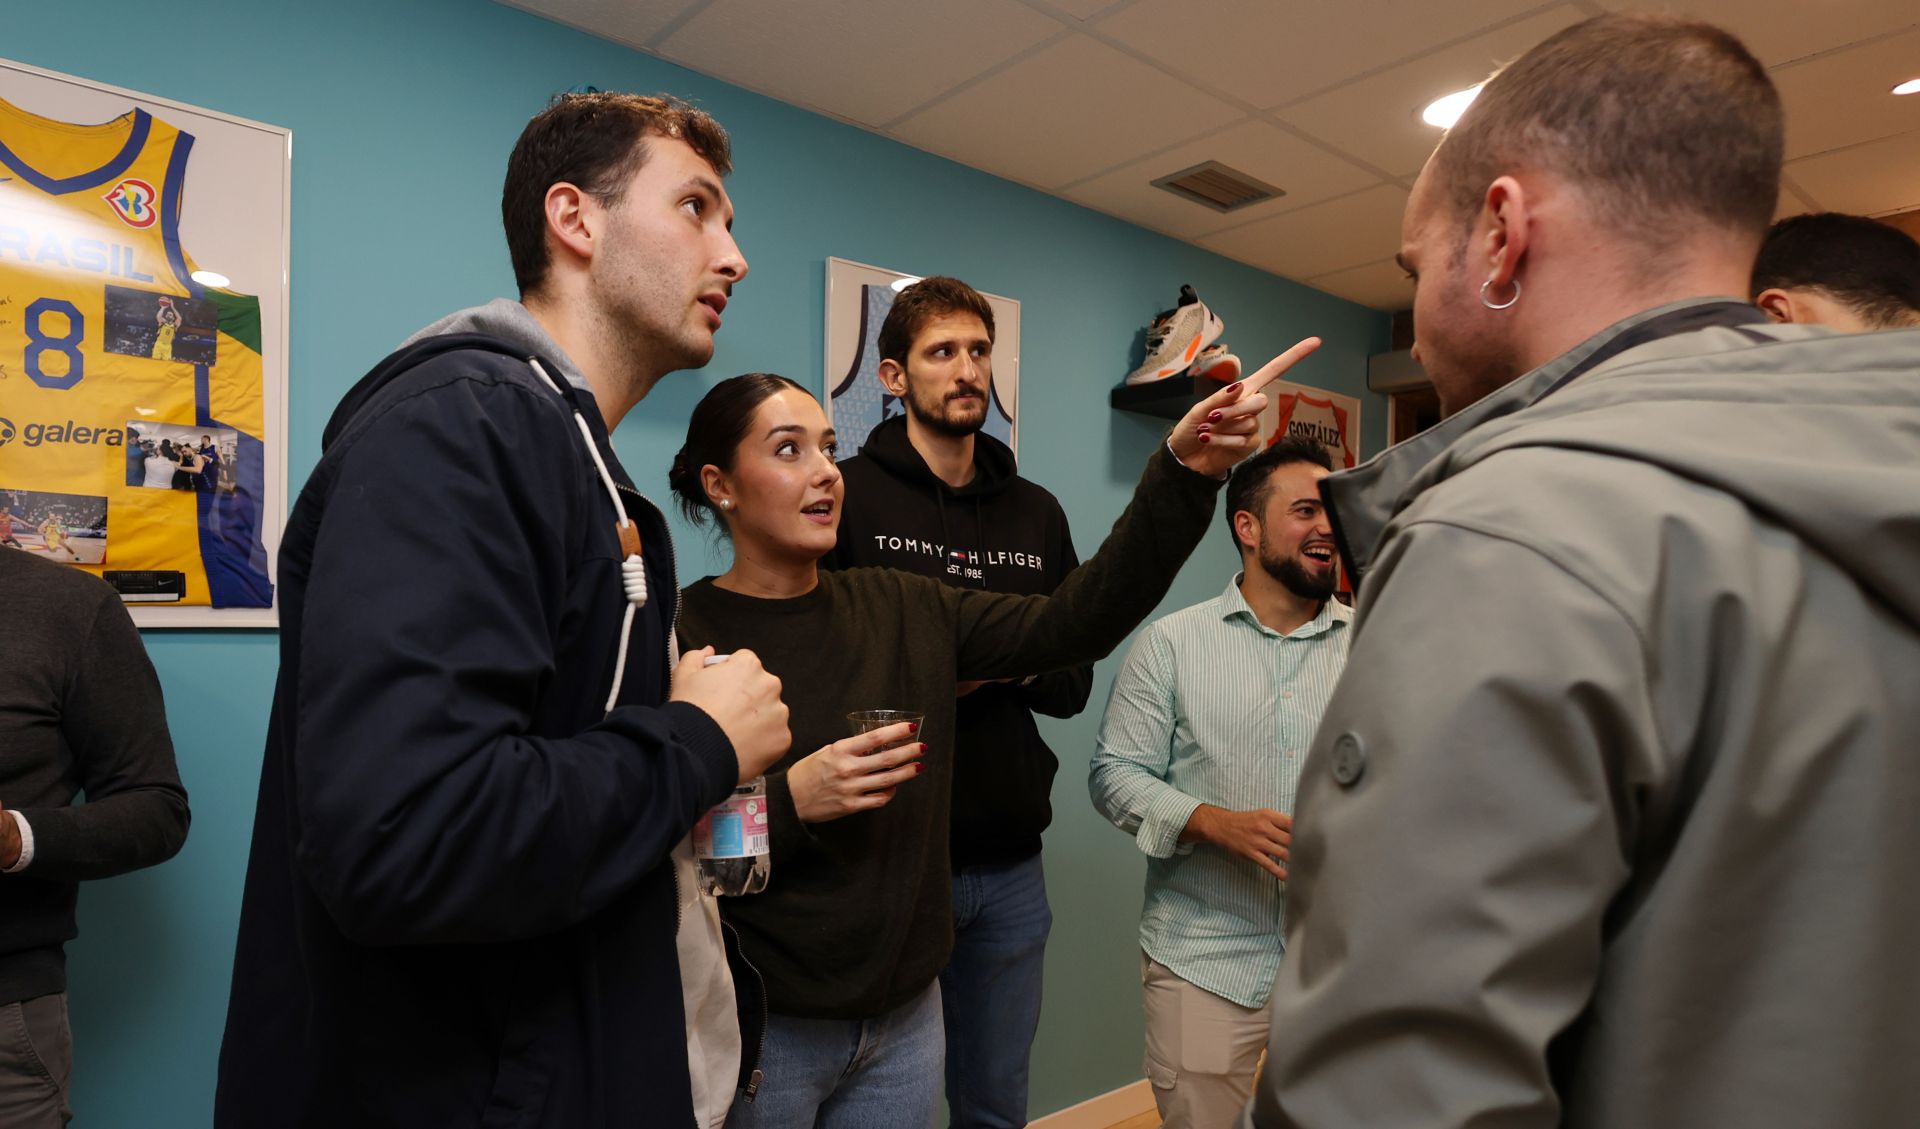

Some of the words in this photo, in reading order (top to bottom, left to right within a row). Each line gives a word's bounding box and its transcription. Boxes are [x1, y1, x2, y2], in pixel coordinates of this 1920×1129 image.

[24, 297, 84, 390] 8
[23, 420, 124, 447] galera
[1289, 420, 1340, 448] GONZÁLEZ
[874, 535, 944, 558] TOMMY
